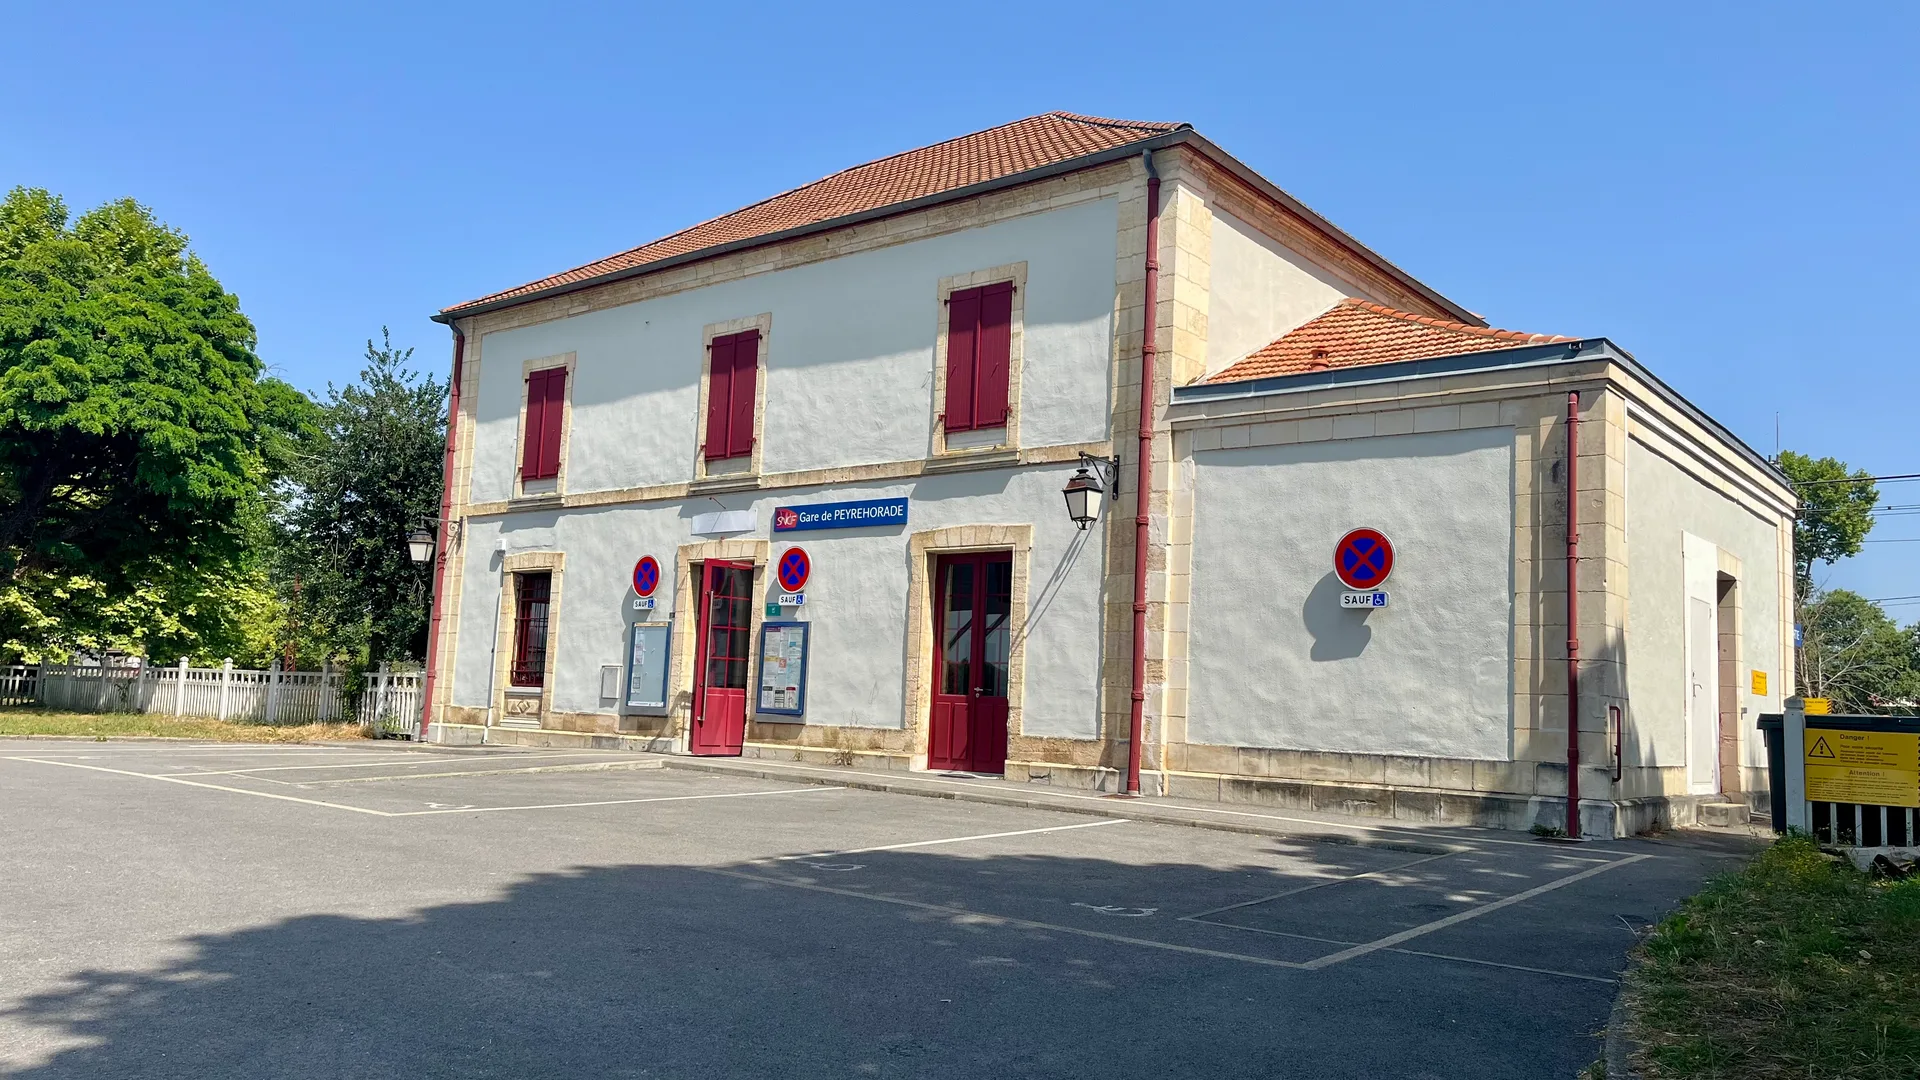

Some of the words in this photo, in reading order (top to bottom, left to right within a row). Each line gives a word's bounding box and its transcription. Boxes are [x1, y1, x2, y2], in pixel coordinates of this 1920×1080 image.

[776, 512, 798, 527] SNCF
[799, 511, 820, 523] Gare
[821, 510, 832, 521] de
[834, 504, 904, 520] PEYREHORADE
[634, 600, 648, 608] SAUF
[780, 596, 796, 604] SAUF
[1344, 595, 1371, 605] SAUF
[1849, 769, 1880, 777] Attention
